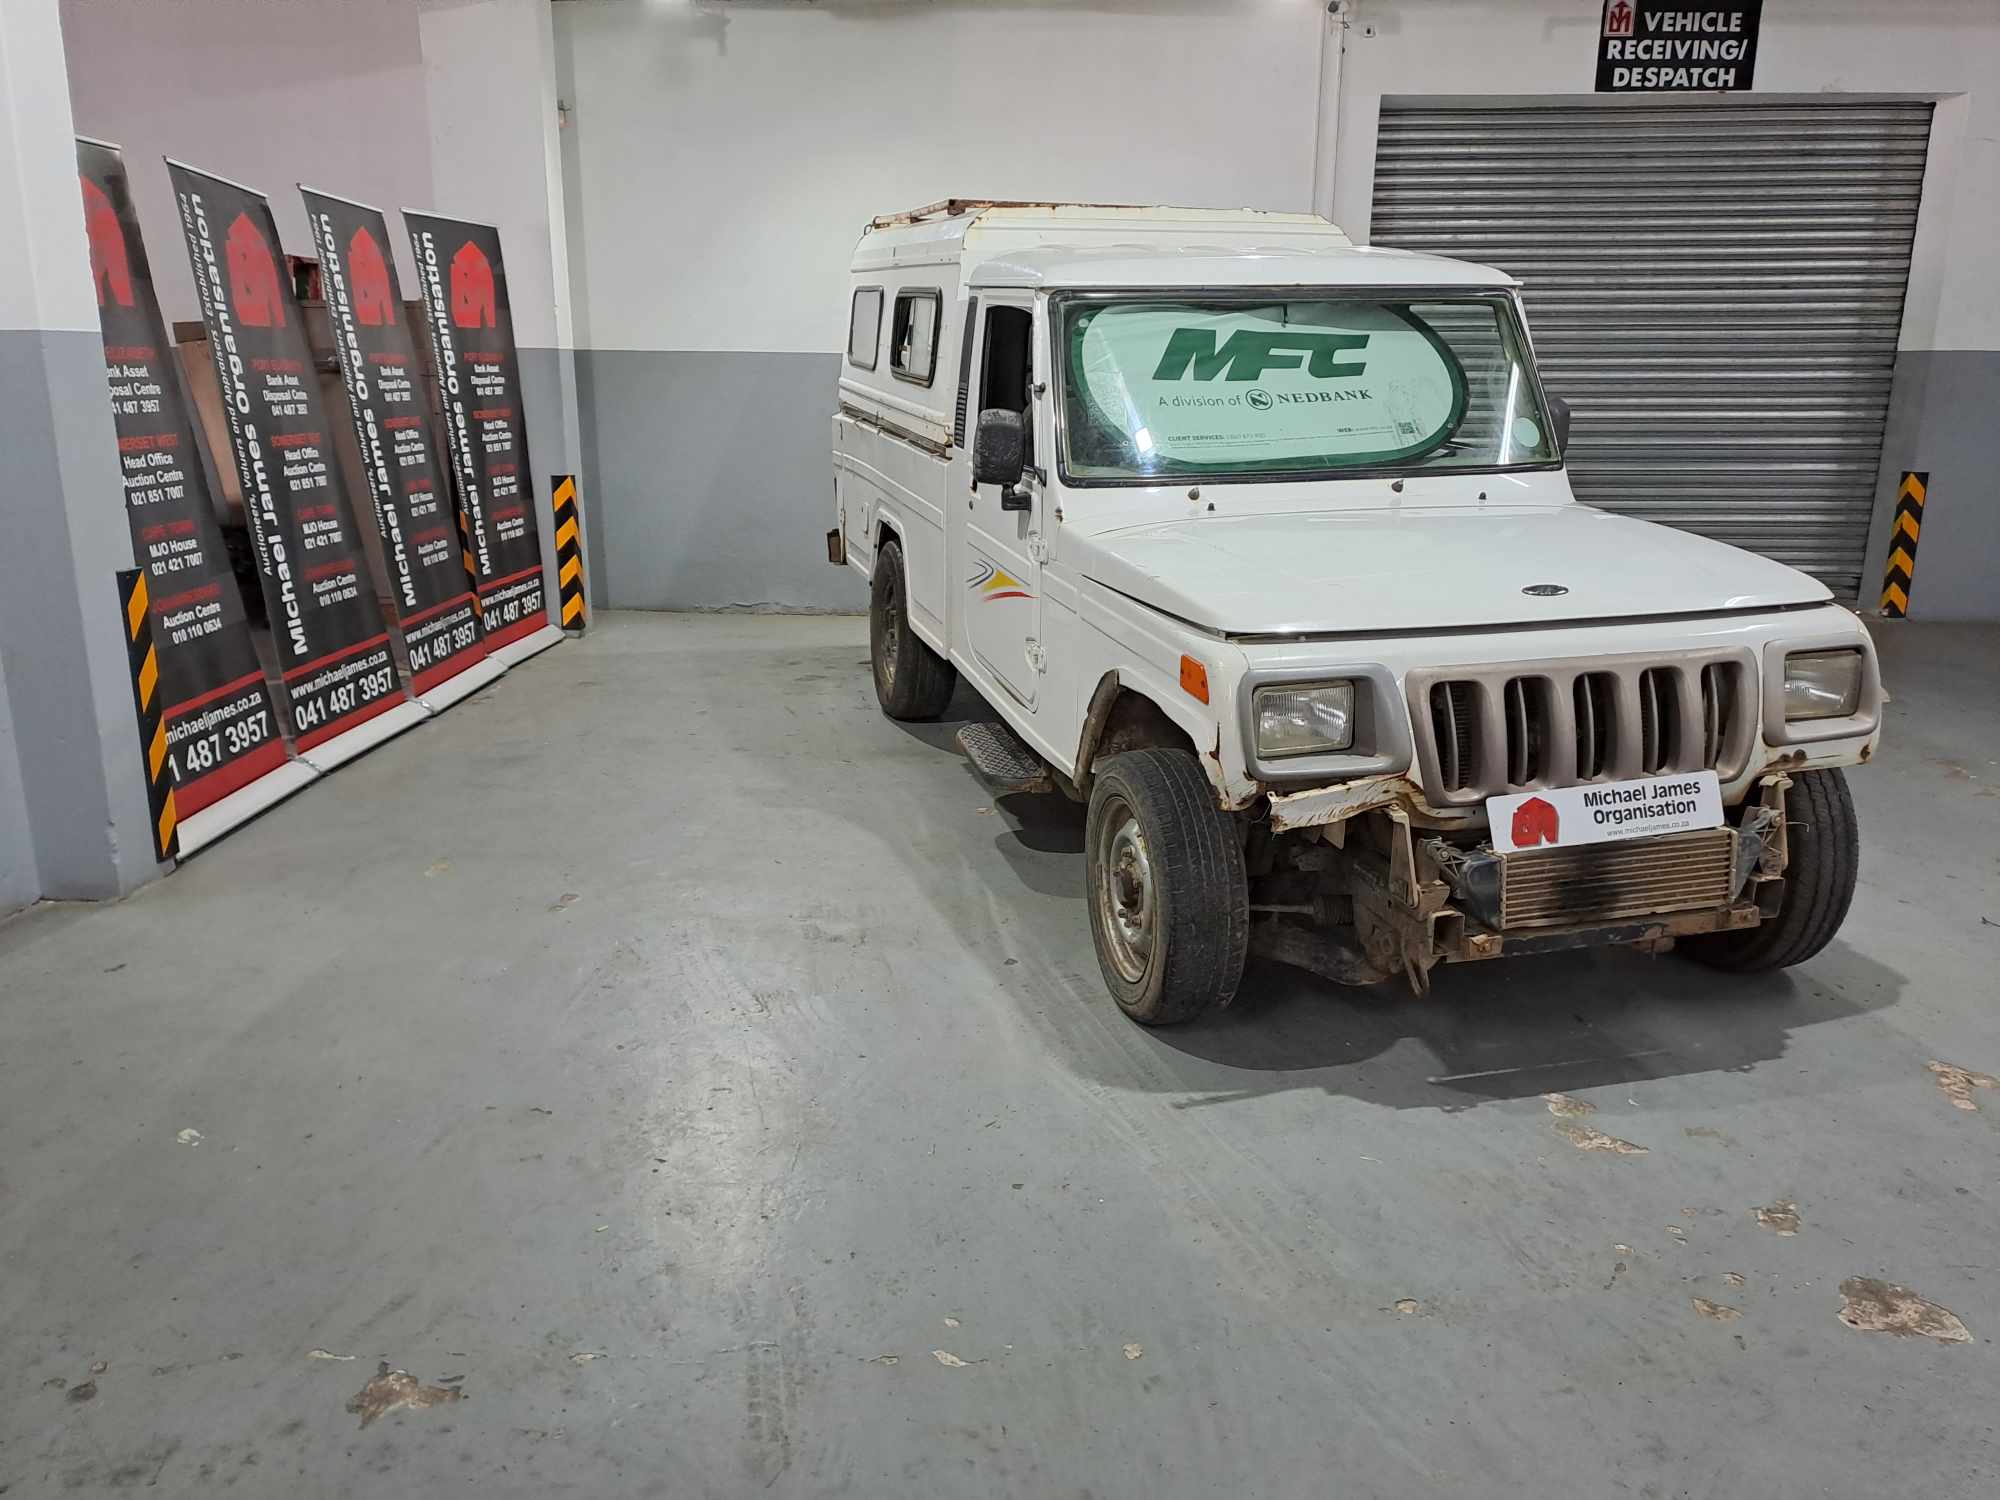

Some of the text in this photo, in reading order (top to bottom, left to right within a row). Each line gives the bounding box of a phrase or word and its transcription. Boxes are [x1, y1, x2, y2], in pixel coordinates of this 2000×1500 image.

[1644, 12, 1743, 32] VEHICLE
[1607, 39, 1749, 61] RECEIVING/
[1612, 67, 1737, 88] DESPATCH
[180, 192, 194, 229] 1964
[188, 232, 214, 317] Established
[320, 214, 369, 400] Organisation
[211, 329, 233, 404] Appraisers
[1152, 327, 1371, 382] MFC
[123, 364, 149, 378] Asset
[133, 382, 161, 395] Centre
[1158, 388, 1373, 407] A division of NEDBANK
[122, 400, 138, 414] 487
[140, 399, 160, 413] 3957
[422, 232, 491, 575] Michael James Organisation
[191, 193, 308, 656] Michael James Organisation
[227, 406, 240, 434] and
[123, 453, 174, 469] Head Office
[235, 438, 252, 488] Valuers
[363, 408, 392, 496] James
[122, 470, 184, 488] Auction Centre
[131, 486, 184, 505] 021 851 7007
[149, 539, 198, 558] MJO House
[249, 494, 272, 576] Auctioneers,
[152, 562, 168, 576] 021
[168, 557, 184, 572] 421
[383, 503, 416, 607] Michael
[163, 602, 221, 629] Auction Centre
[483, 590, 542, 631] 041 487 3957
[172, 630, 188, 644] 010
[187, 623, 203, 640] 110
[409, 621, 476, 671] 041 487 3957
[290, 651, 388, 699] www.michaeljames.co.za
[295, 667, 393, 730] 041 487 3957
[186, 733, 222, 772] 487
[225, 710, 268, 753] 3957
[1584, 780, 1701, 808] Michael James
[1593, 799, 1697, 825] Organisation
[1606, 820, 1690, 838] www.michaeljames.co.za
